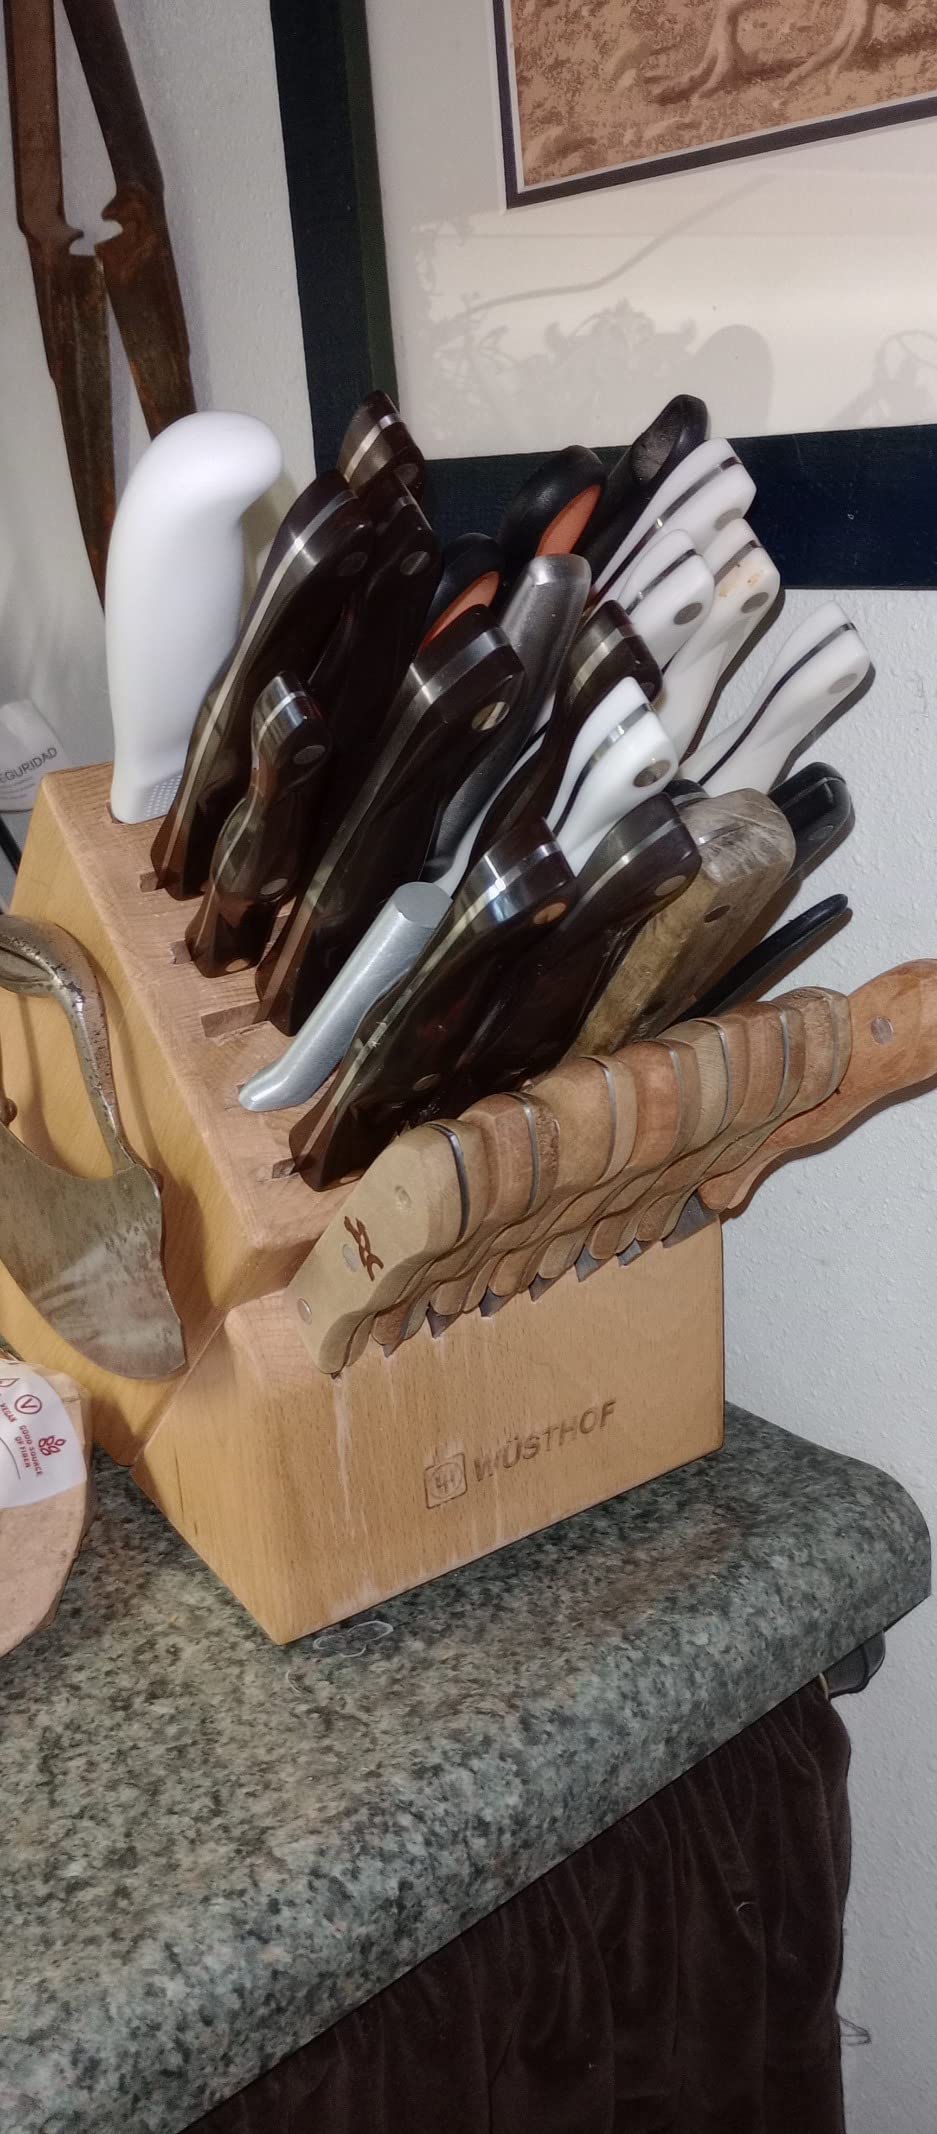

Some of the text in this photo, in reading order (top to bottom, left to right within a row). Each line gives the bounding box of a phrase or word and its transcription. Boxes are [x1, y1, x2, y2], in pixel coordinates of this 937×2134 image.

[19, 1425, 44, 1476] GOOD SOURCE
[473, 1398, 617, 1482] WÜSTHOF
